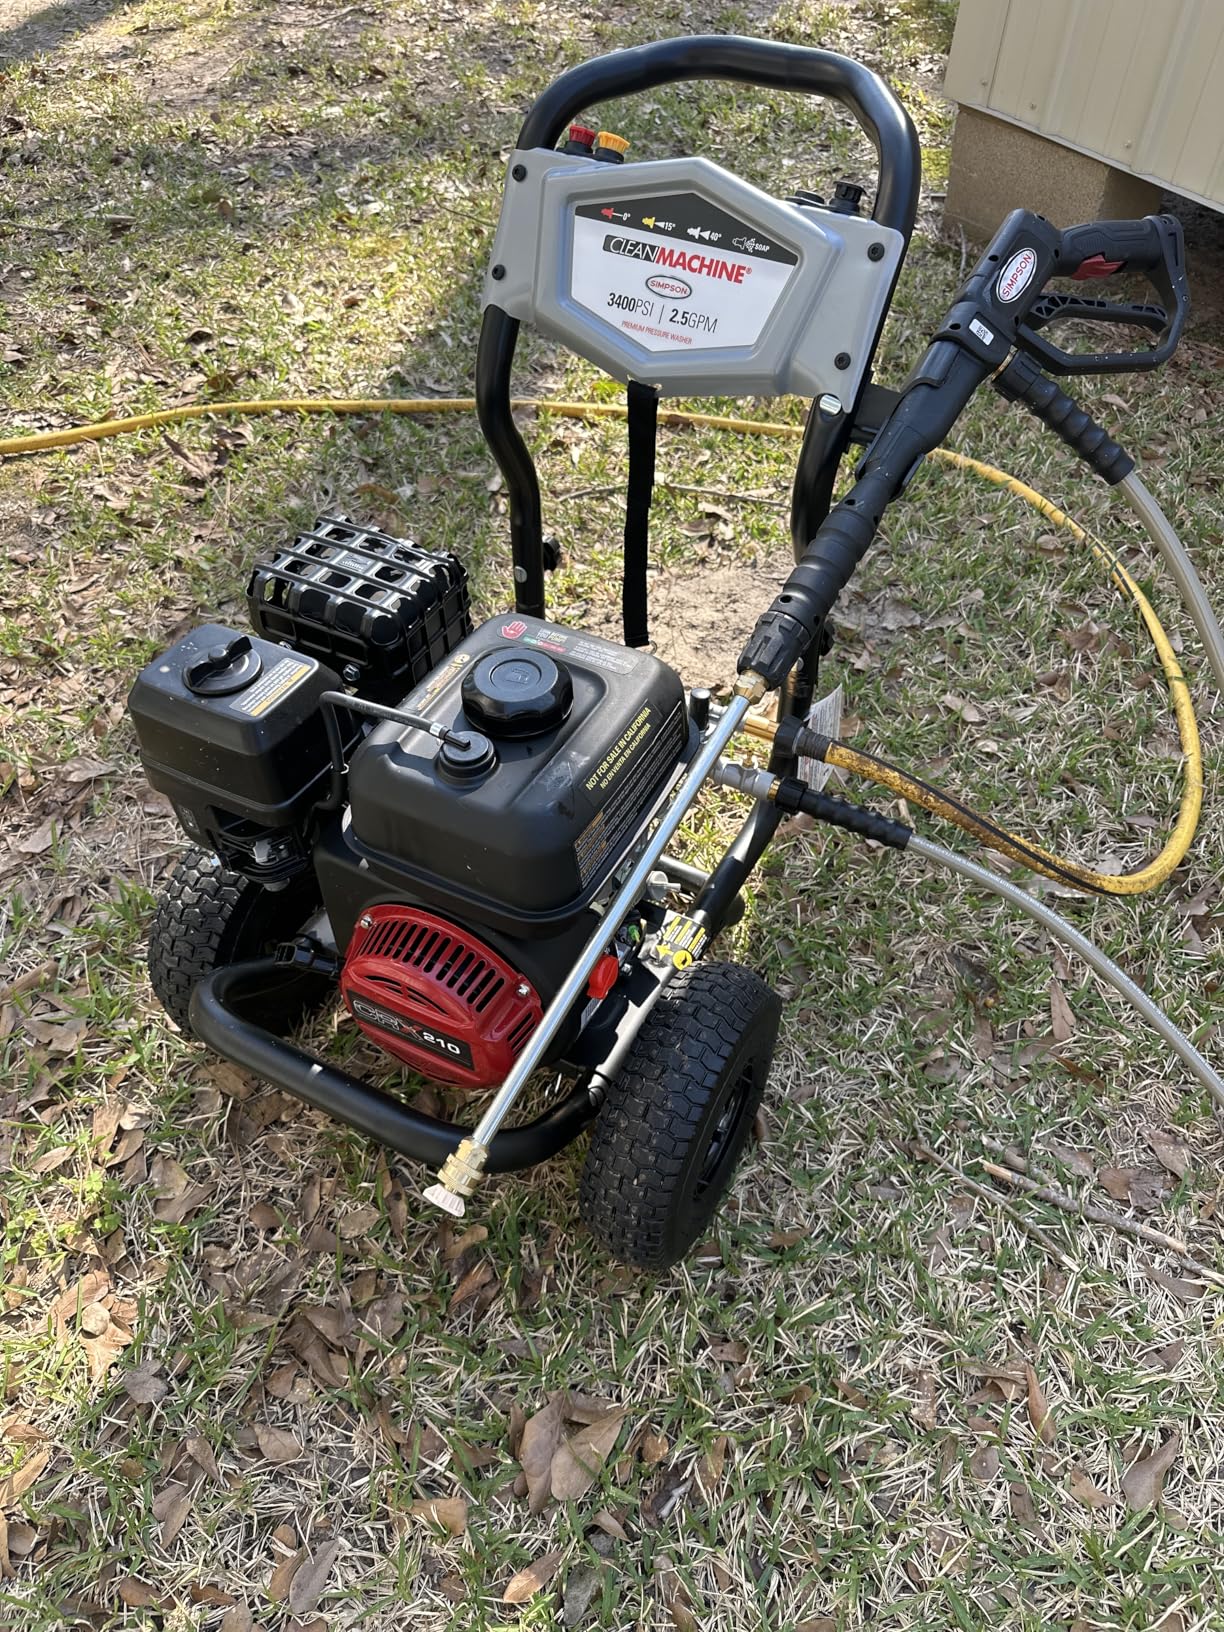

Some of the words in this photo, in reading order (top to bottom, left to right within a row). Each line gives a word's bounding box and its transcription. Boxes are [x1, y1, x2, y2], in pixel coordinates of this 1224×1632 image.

[665, 221, 676, 231] 15°
[754, 243, 770, 252] SOAP
[649, 279, 688, 295] SIMPSON
[1002, 253, 1032, 297] SIMPSON
[607, 292, 655, 317] 3400PSI
[668, 308, 718, 334] 2.5GPM
[621, 320, 645, 333] PREMIUM
[644, 327, 670, 339] PRESSURE
[670, 333, 693, 345] WASHER
[585, 774, 600, 791] NOT
[596, 761, 610, 777] FOR
[606, 745, 622, 764] SALE
[618, 738, 627, 749] IN
[623, 707, 652, 742] CALIFORNIA
[599, 778, 609, 790] NO
[607, 770, 615, 782] EN
[612, 755, 627, 773] VENTA
[623, 748, 632, 759] EN
[629, 722, 651, 751] CALIFORNIA
[422, 1031, 461, 1055] 210
